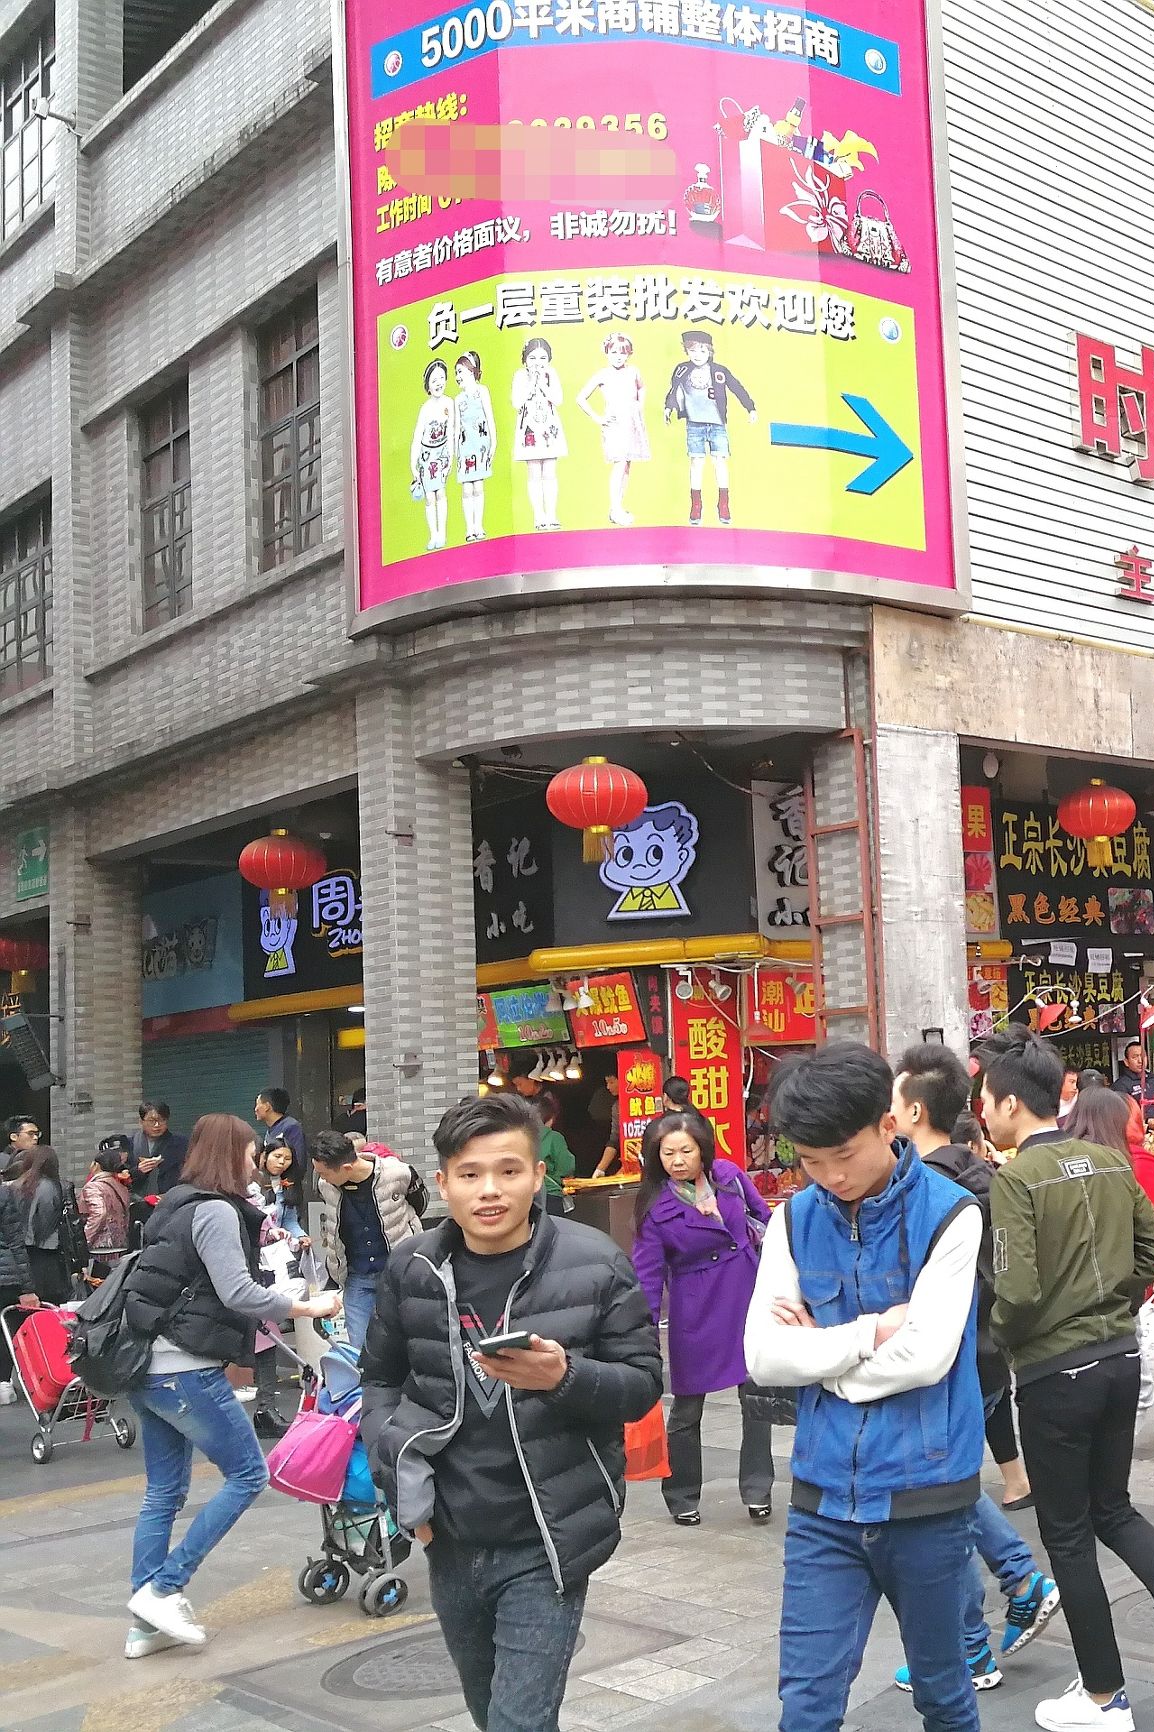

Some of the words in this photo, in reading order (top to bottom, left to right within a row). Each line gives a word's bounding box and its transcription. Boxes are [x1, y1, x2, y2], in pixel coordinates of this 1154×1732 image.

[420, 0, 841, 67] 5000平米商铺整体招商
[376, 193, 432, 234] 工作时间
[427, 274, 858, 351] 负一层童装批发欢迎您
[312, 875, 363, 929] 周
[1008, 891, 1106, 927] 黑色经典
